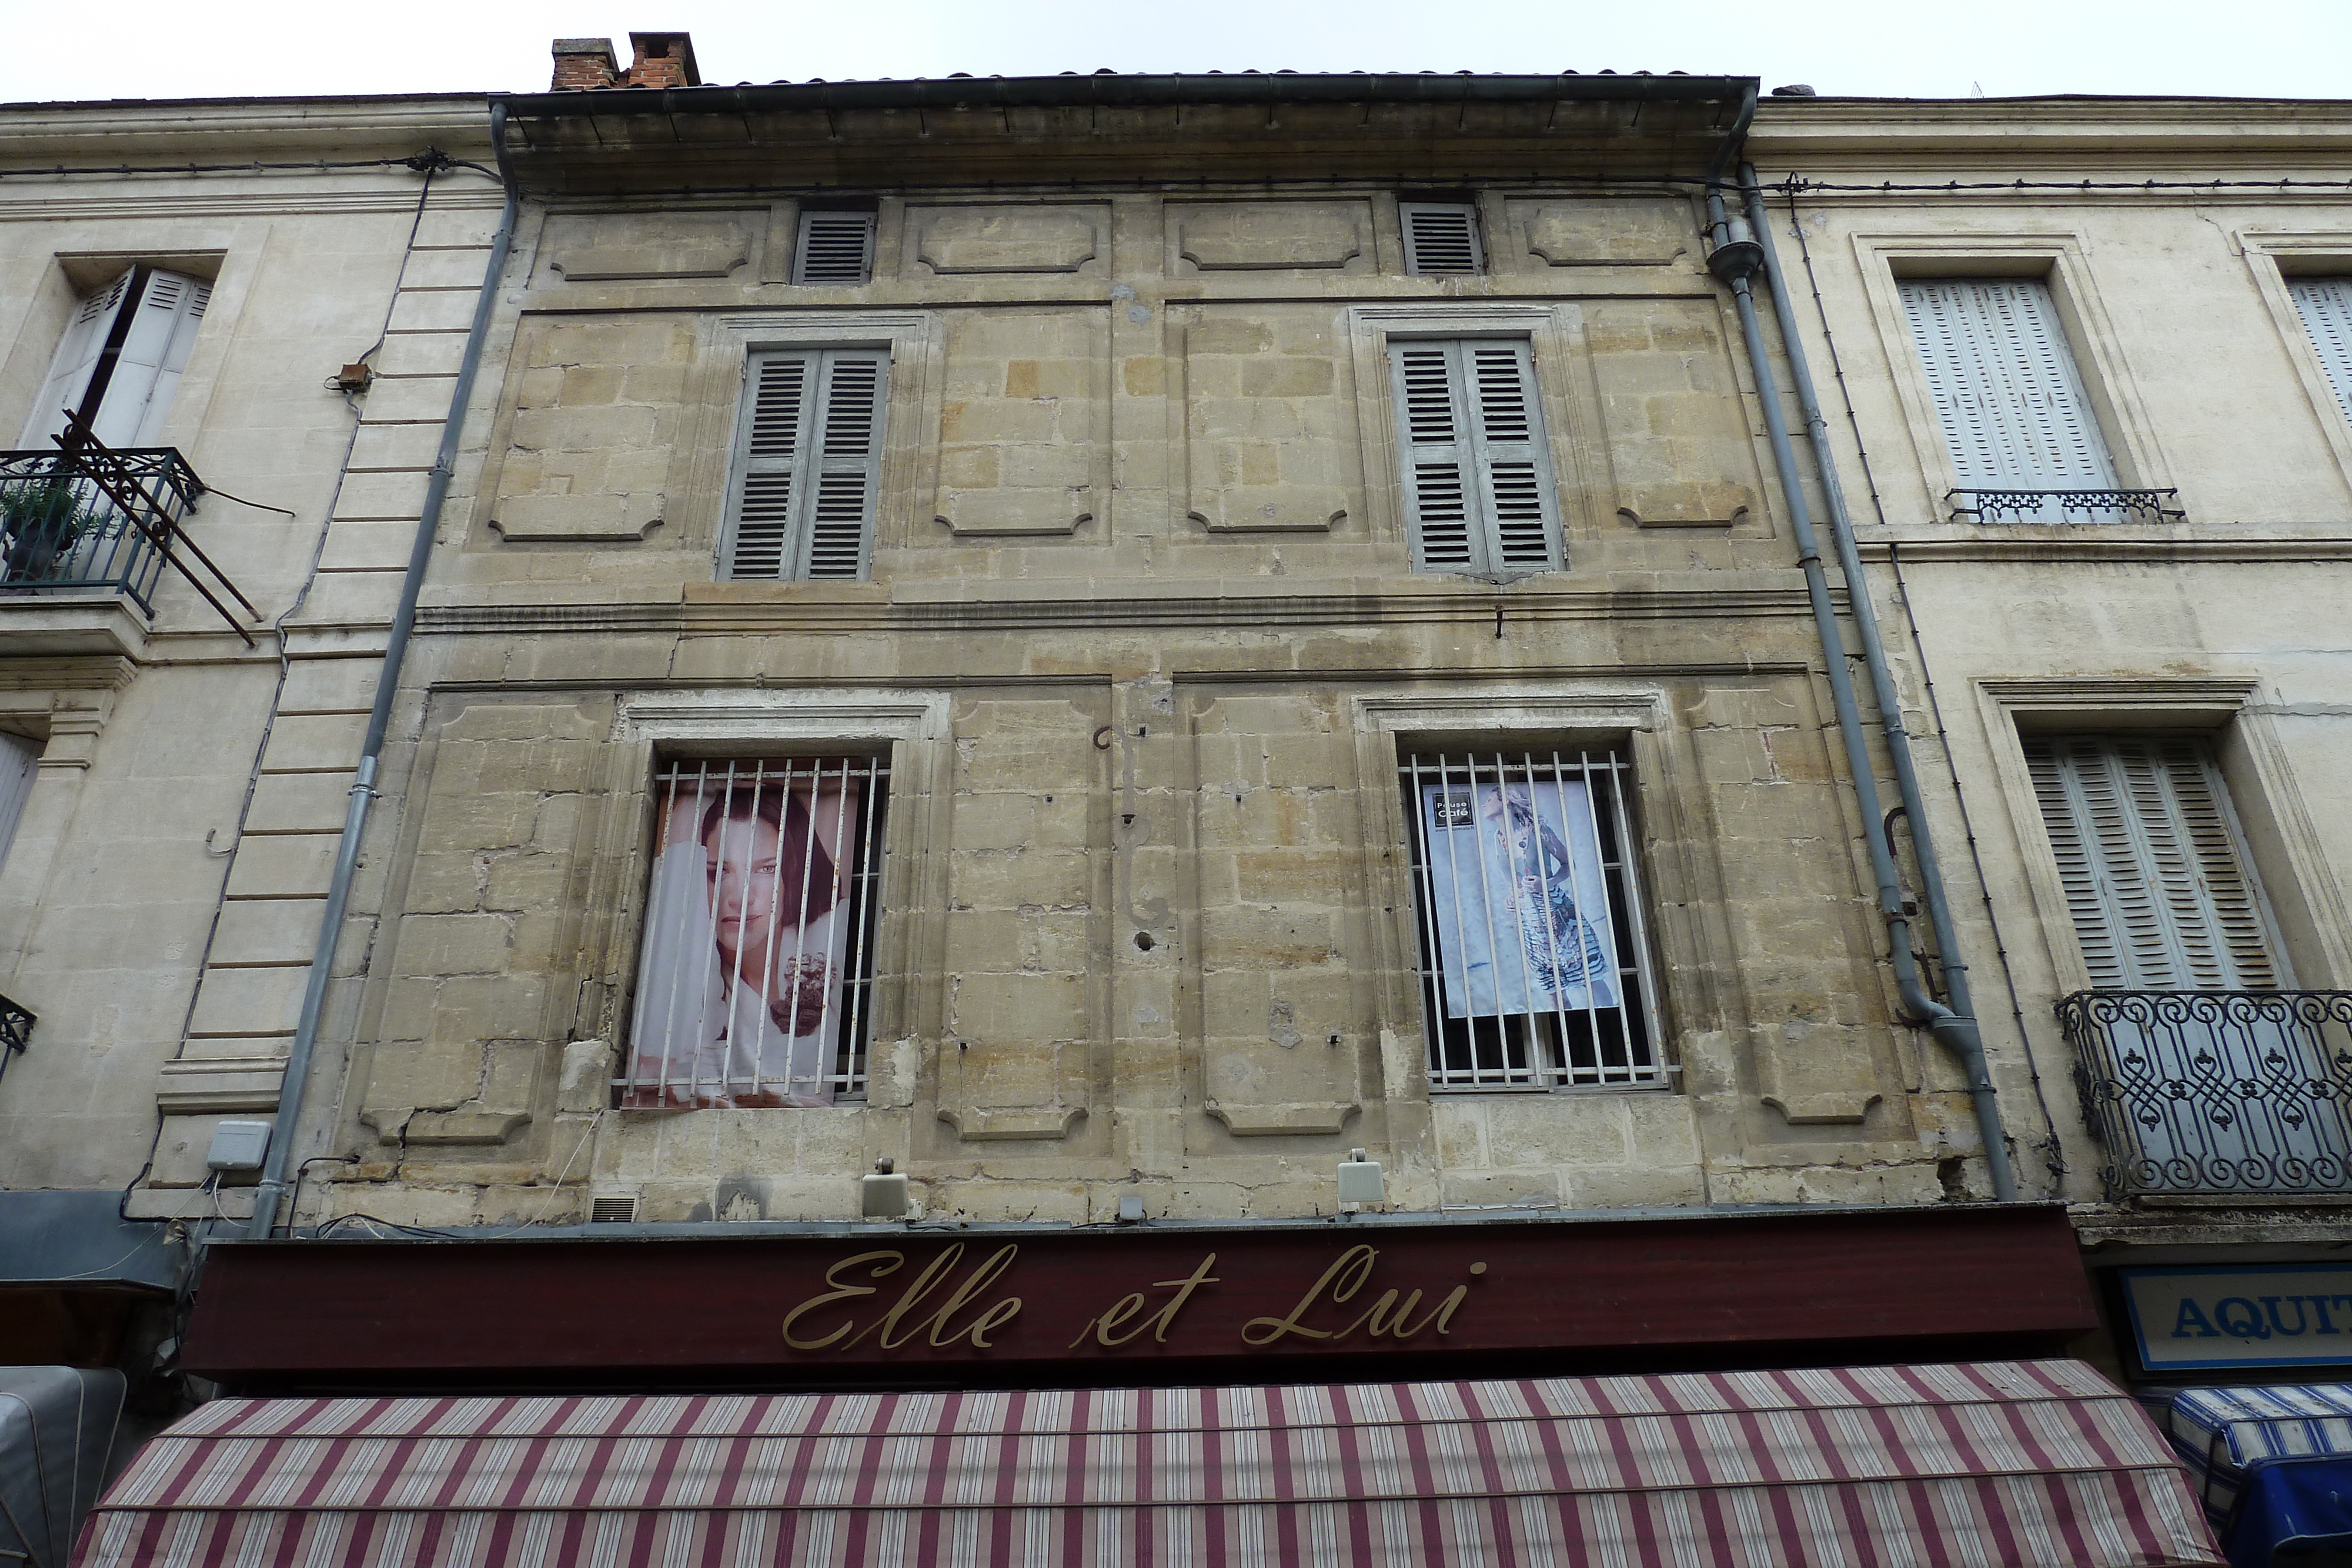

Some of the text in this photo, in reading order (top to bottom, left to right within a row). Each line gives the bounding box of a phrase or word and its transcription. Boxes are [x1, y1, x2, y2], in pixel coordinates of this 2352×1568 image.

[1438, 808, 1468, 817] Café
[783, 1242, 1487, 1350] Elle et Lui
